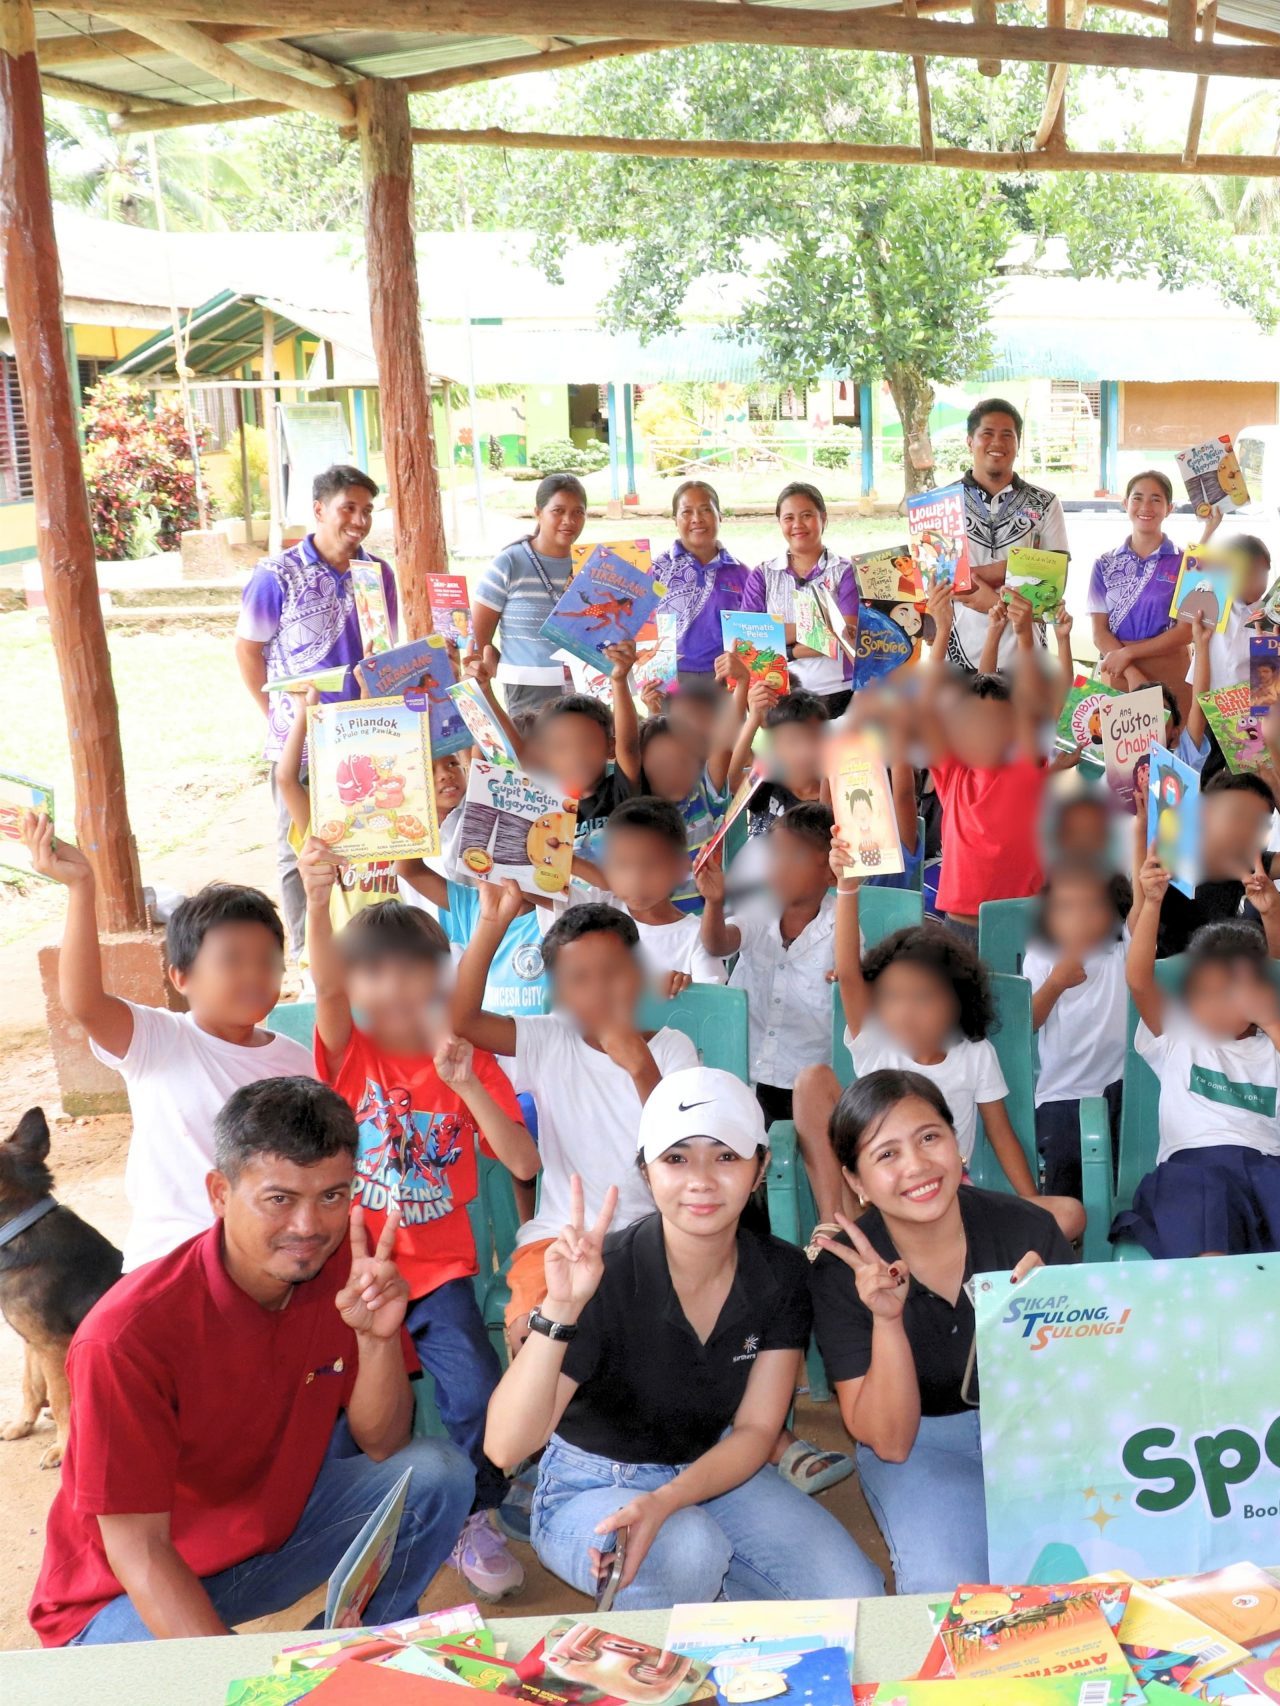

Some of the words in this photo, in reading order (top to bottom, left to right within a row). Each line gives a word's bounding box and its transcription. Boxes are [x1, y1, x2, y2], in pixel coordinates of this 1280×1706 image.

[910, 494, 961, 523] Mamon
[910, 513, 964, 538] Filemon
[741, 623, 774, 632] Kamatis
[349, 717, 399, 729] Pilandok
[1120, 708, 1132, 717] Ang
[371, 727, 401, 738] Pawikan
[1111, 713, 1151, 741] Gusto
[488, 779, 521, 798] Gupit
[524, 788, 559, 807] Natin
[492, 793, 548, 815] Ngayon?
[522, 986, 542, 1006] CITY
[1022, 1306, 1110, 1338] TULONG,
[1030, 1308, 1132, 1351] SULONG!
